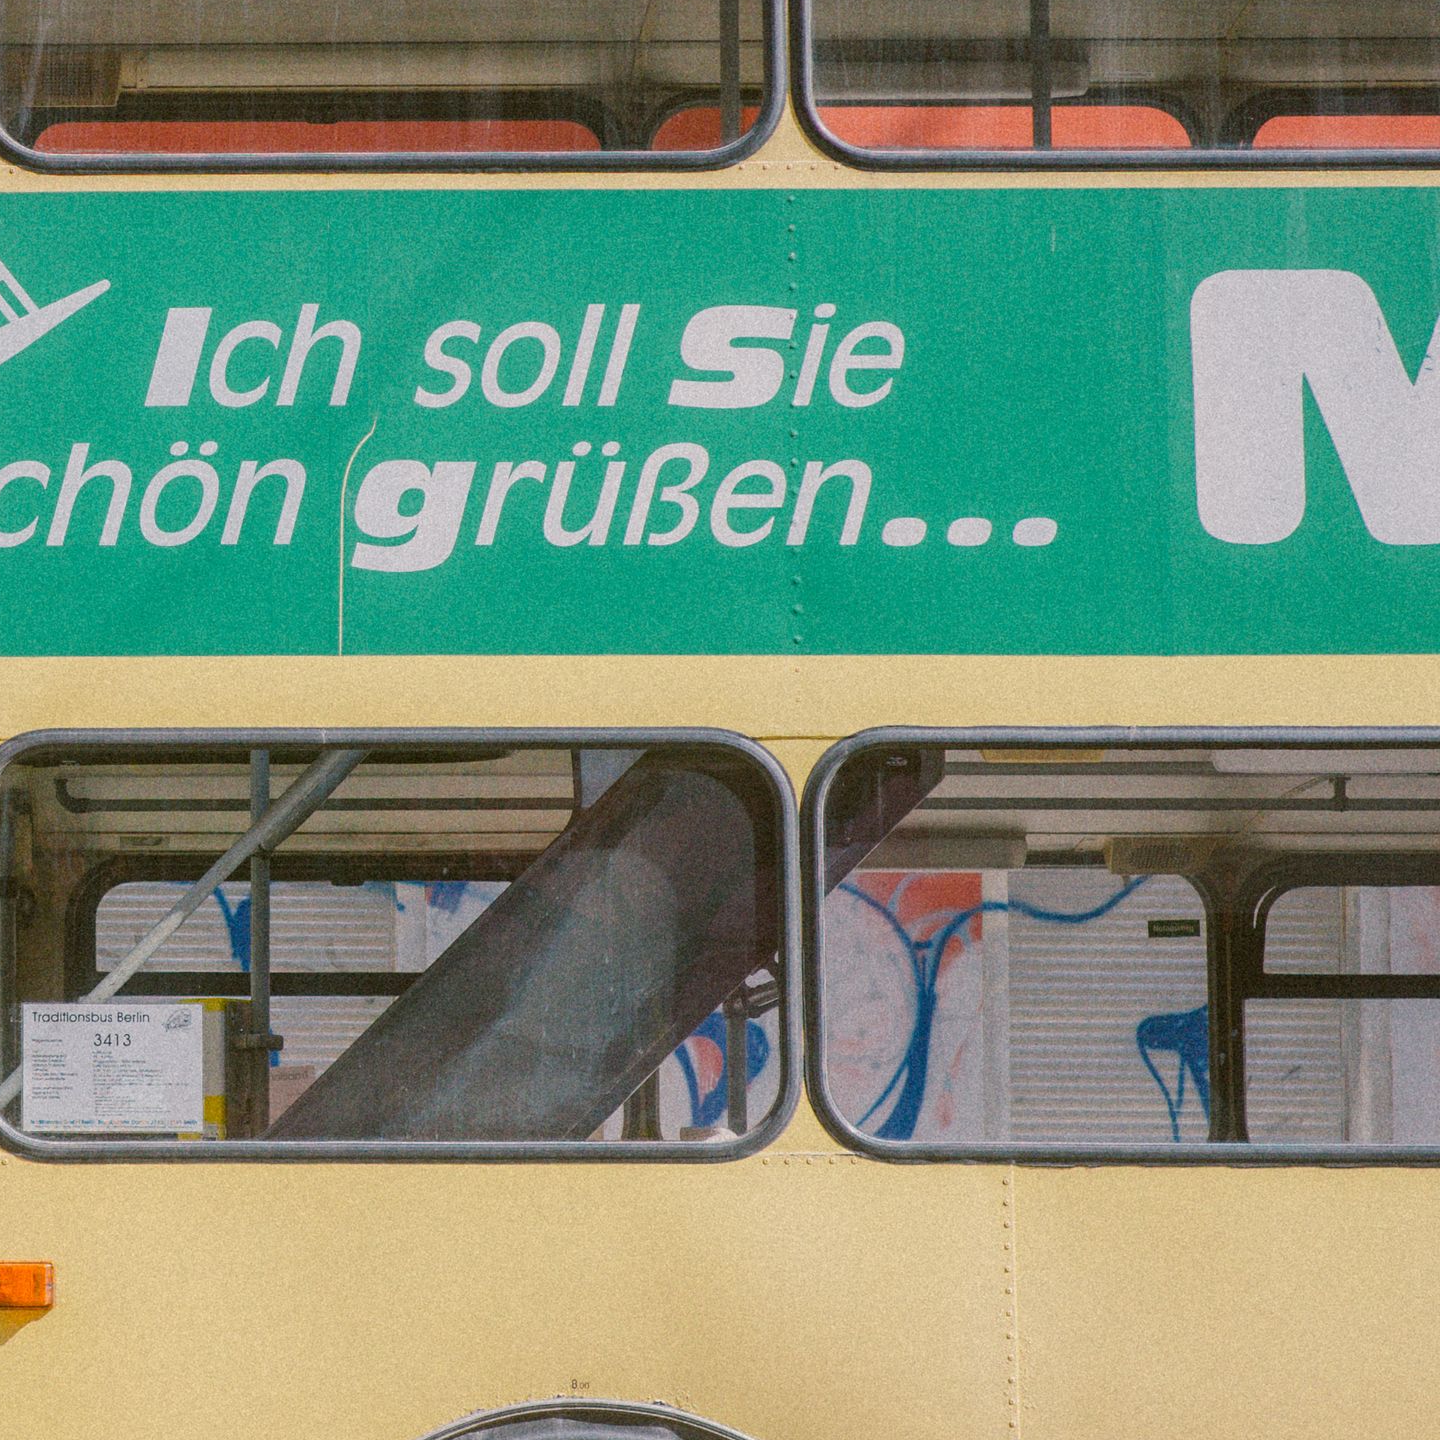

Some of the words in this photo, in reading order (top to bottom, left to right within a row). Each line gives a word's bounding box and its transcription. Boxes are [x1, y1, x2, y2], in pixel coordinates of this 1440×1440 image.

[146, 304, 361, 407] Ich
[416, 304, 639, 408] soll
[669, 304, 904, 409] Sie
[352, 442, 1056, 572] grüßen...
[32, 1011, 112, 1023] Traditionsbus
[117, 1011, 150, 1023] Berlin
[93, 1033, 132, 1047] 3413
